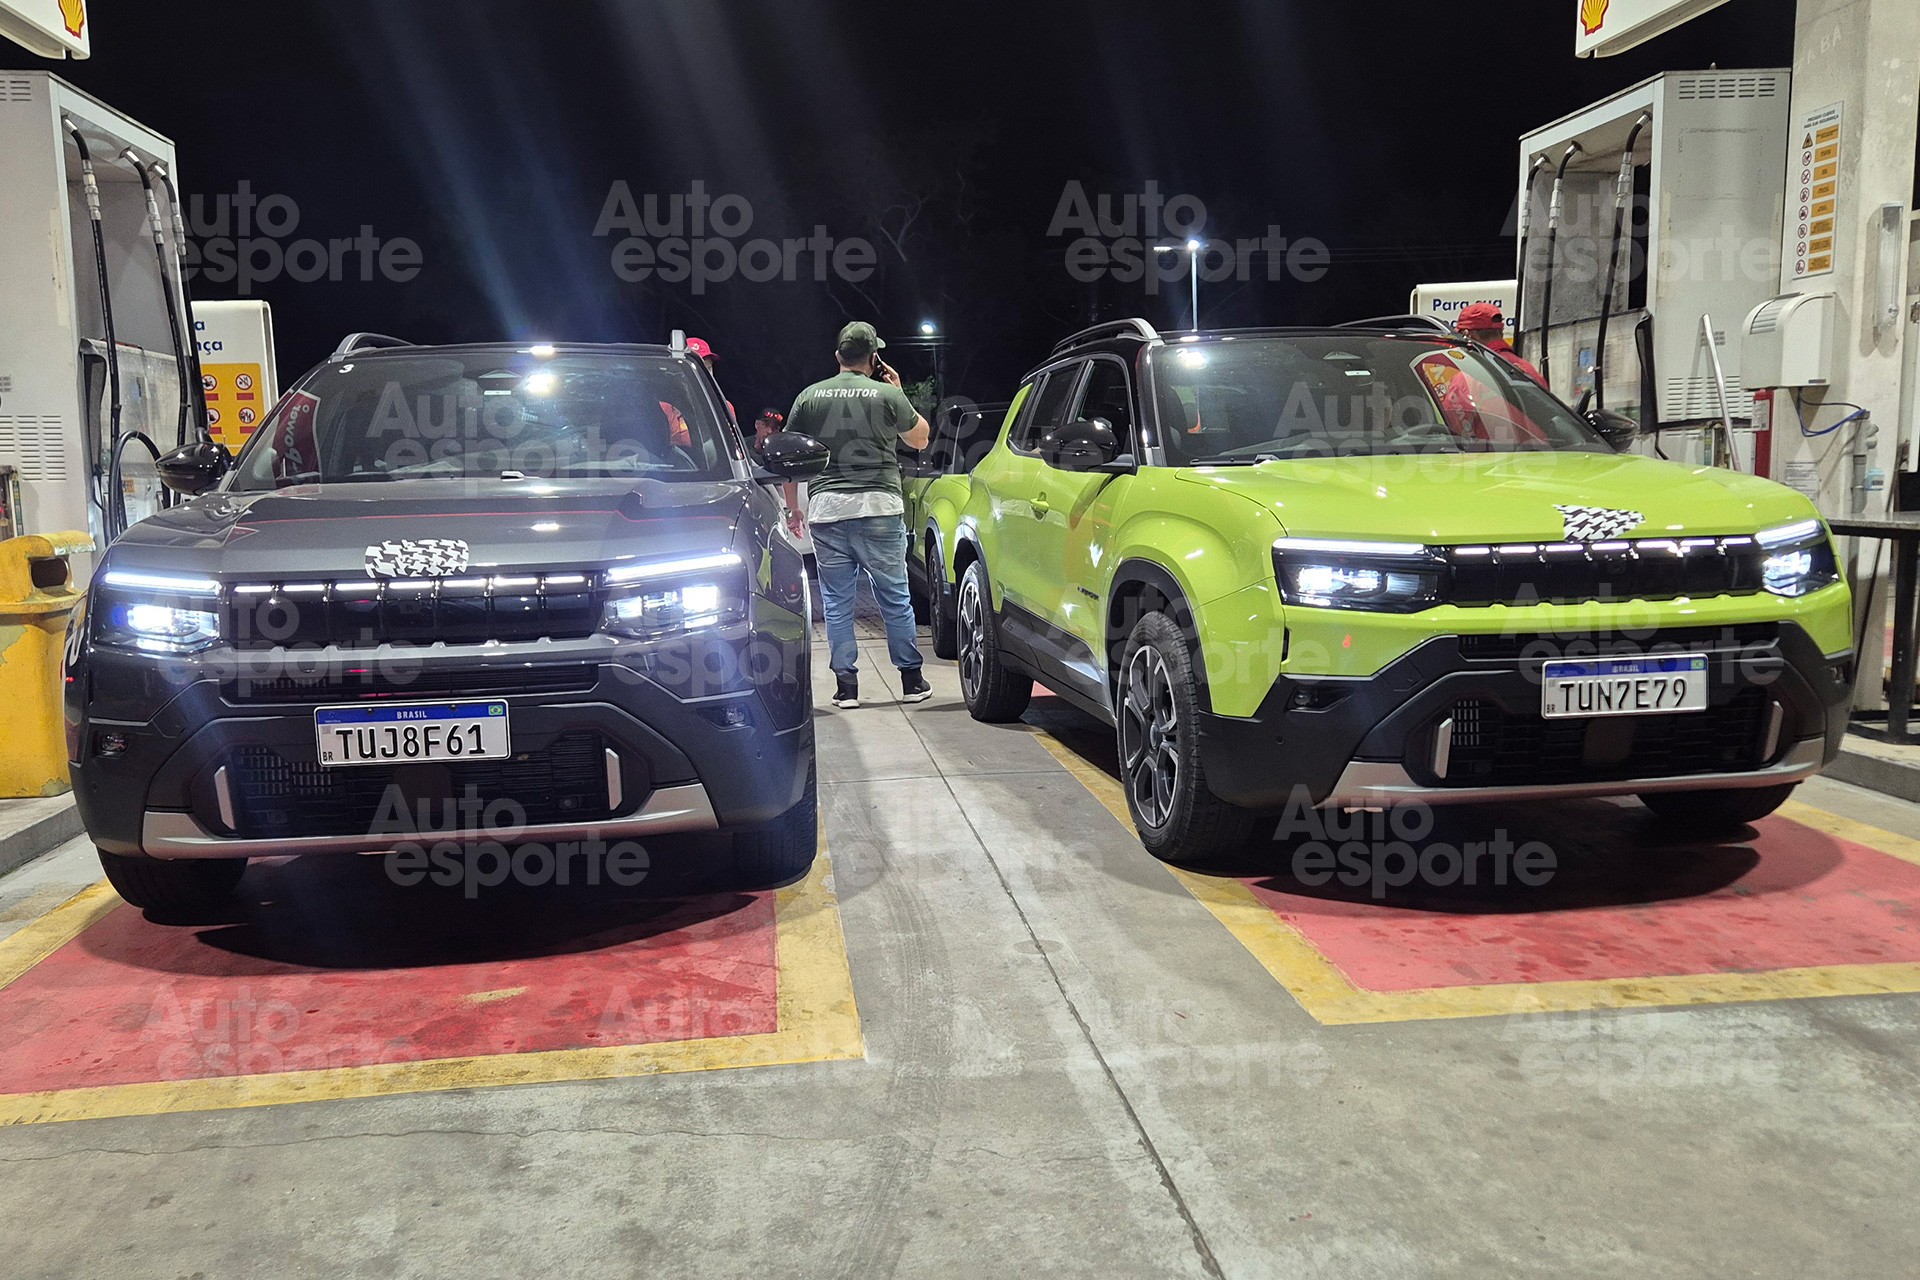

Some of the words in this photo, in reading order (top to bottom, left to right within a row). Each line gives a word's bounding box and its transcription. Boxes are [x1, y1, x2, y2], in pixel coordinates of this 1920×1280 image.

[1433, 298, 1469, 311] Para
[814, 388, 879, 398] INSTRUTOR
[1559, 676, 1688, 712] TUN7E79
[396, 710, 428, 720] BRASIL
[335, 723, 486, 760] TUJ8F61
[322, 751, 334, 762] BR
